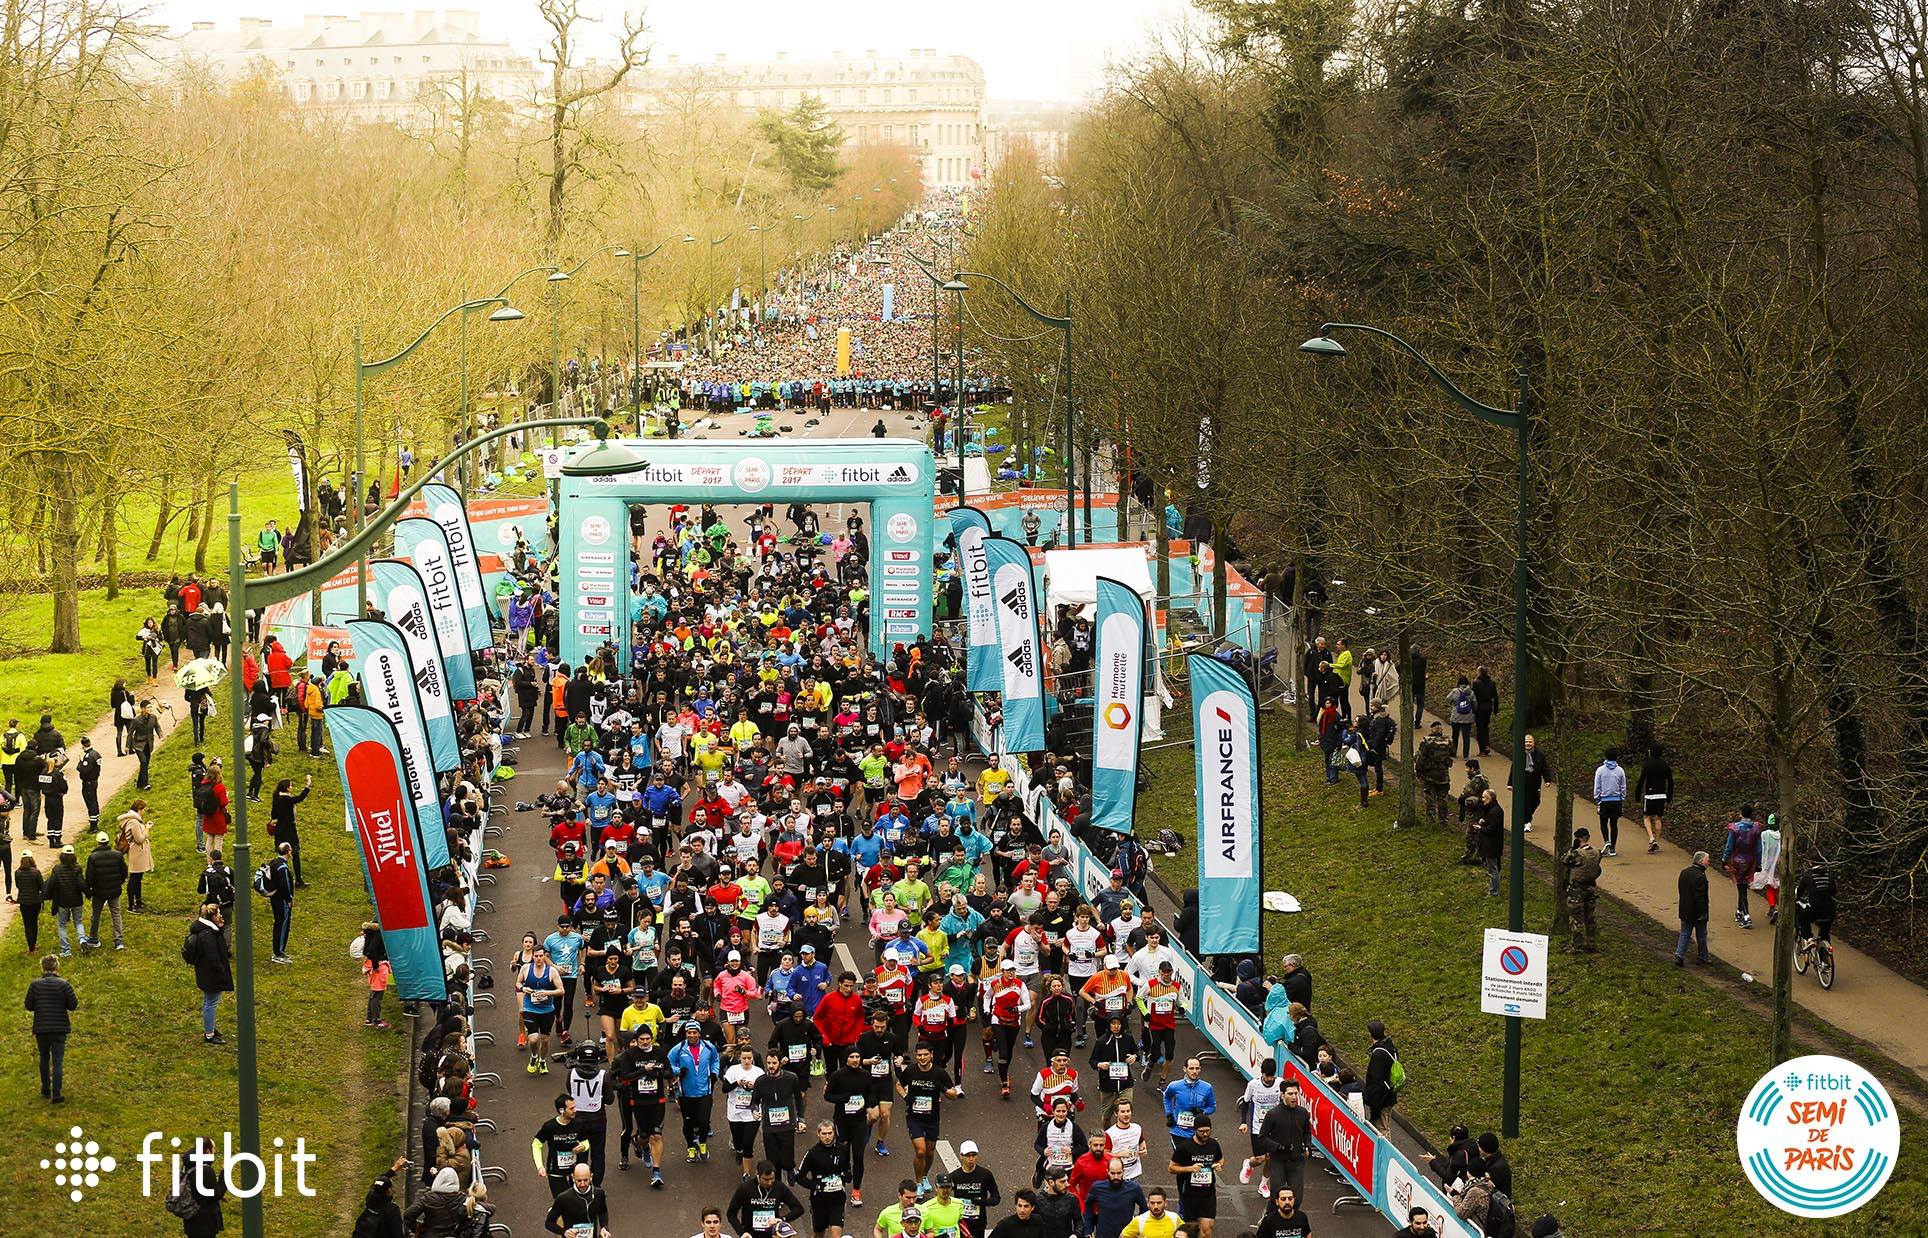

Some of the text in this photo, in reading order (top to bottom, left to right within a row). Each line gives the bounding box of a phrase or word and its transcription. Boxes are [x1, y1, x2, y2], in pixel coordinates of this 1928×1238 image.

[593, 475, 617, 483] adidas
[644, 467, 683, 483] fitbit
[702, 476, 722, 485] 2017
[782, 466, 813, 476] DÉPART
[782, 476, 802, 485] 2017
[842, 467, 880, 482] fitbit
[886, 475, 912, 483] adidas
[443, 517, 469, 567] fitbit
[424, 555, 452, 611] fitbit
[968, 543, 990, 599] fitbit
[1017, 580, 1028, 620] adidas
[412, 601, 428, 640] adidas
[426, 658, 441, 697] adidas
[1022, 638, 1033, 678] adidas
[1111, 652, 1120, 699] Harmonie
[1119, 652, 1128, 700] mutuelle
[379, 655, 400, 709] Extenso
[393, 711, 404, 725] In
[591, 704, 605, 716] TV
[1218, 728, 1235, 862] AIRFRANCE
[370, 808, 398, 863] Vittel
[1485, 976, 1522, 984] Stationnement
[573, 1079, 599, 1098] TV
[1333, 1119, 1354, 1162] Vittel
